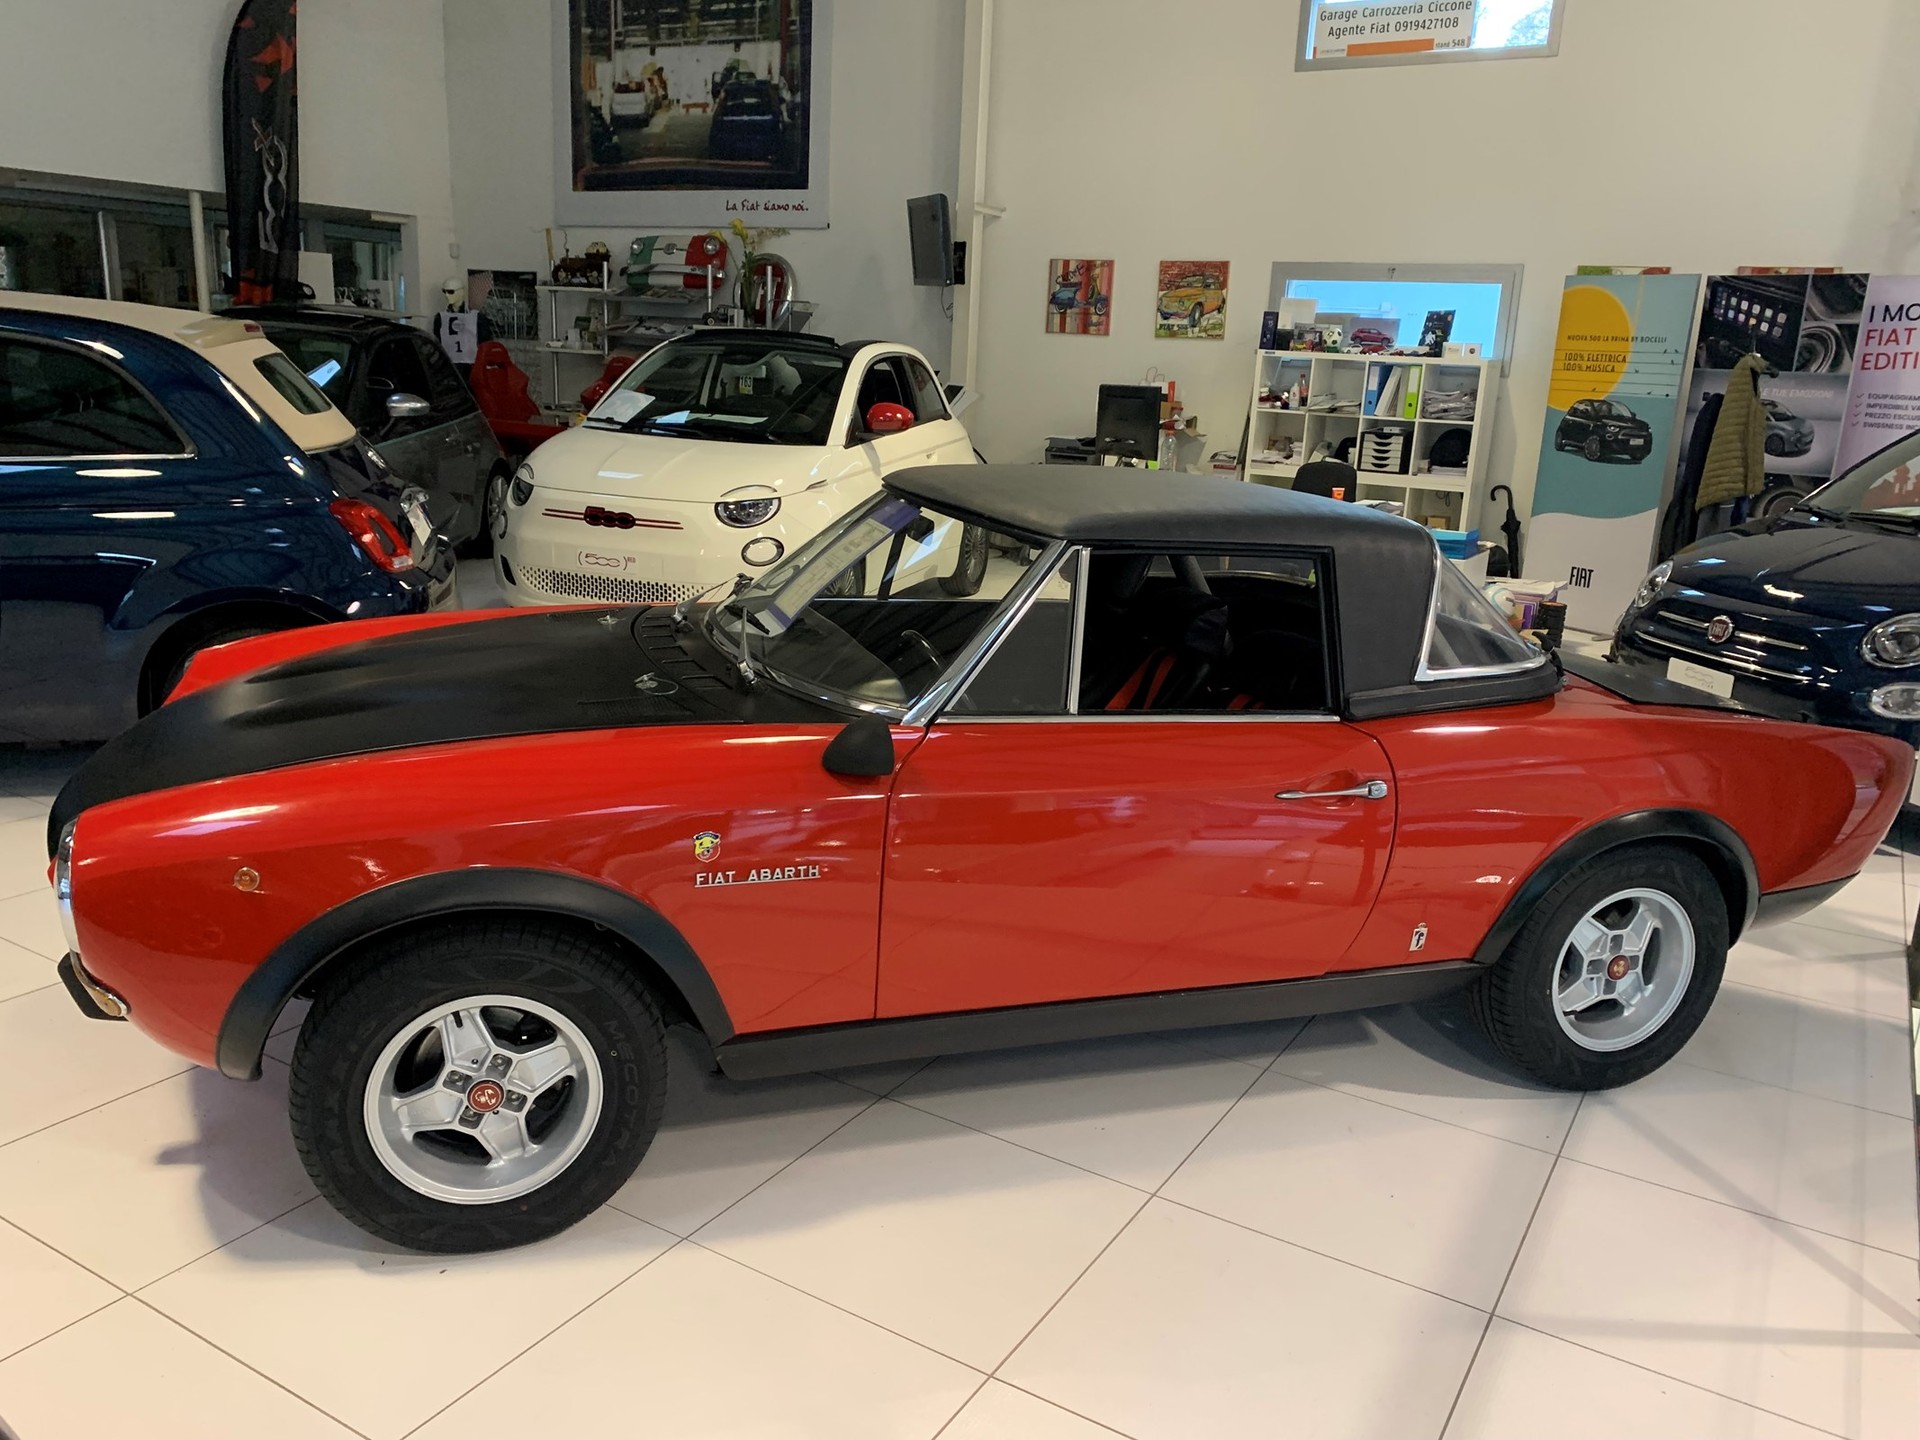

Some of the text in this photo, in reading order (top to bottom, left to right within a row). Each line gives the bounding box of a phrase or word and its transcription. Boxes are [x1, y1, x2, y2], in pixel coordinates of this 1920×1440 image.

[1320, 1, 1473, 22] Garage Carrozzeria Ciccone
[1328, 17, 1459, 39] Agente Fiat 0919427108
[725, 199, 808, 211] La Fiat siamo noi.
[1869, 305, 1875, 323] I
[1865, 327, 1917, 346] FIAT
[455, 341, 463, 353] 1
[1564, 352, 1627, 363] 100% ELETTRICA
[1861, 352, 1919, 370] EDITI
[1563, 362, 1615, 373] 100% MUSICA
[584, 506, 636, 529] 500
[1569, 566, 1594, 589] FIAT
[696, 865, 819, 886] FIAT ABARTH
